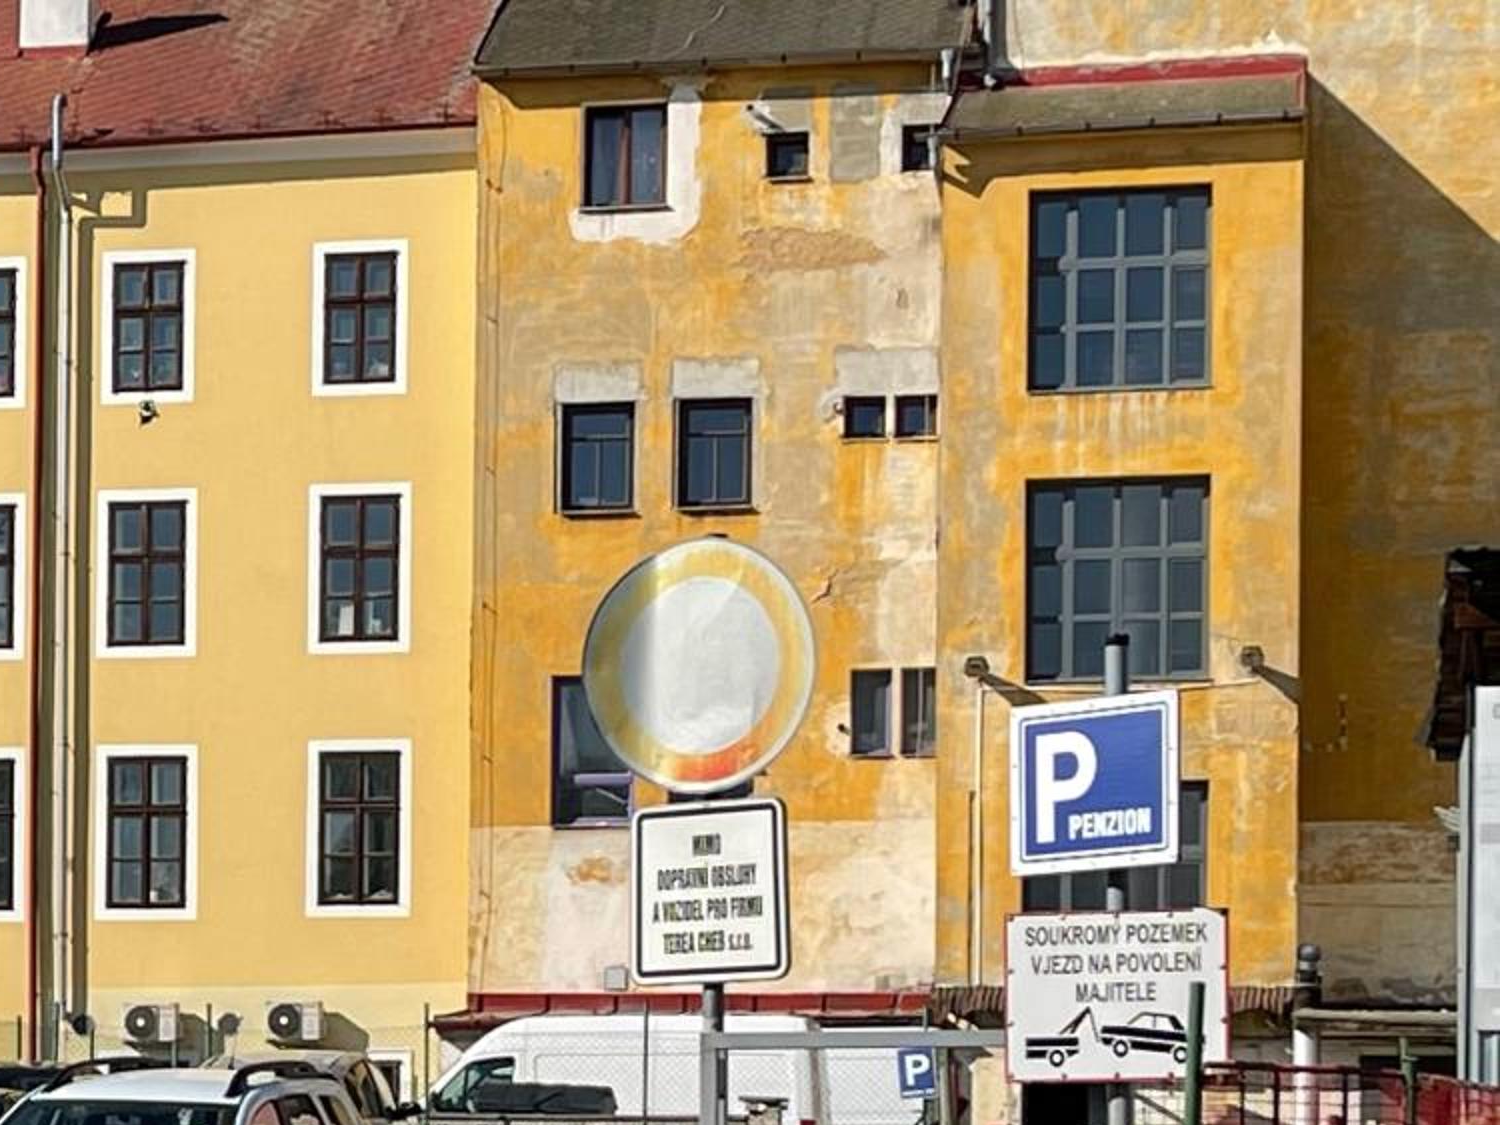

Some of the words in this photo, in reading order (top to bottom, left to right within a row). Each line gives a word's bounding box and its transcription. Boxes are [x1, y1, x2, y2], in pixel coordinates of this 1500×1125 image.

[1035, 730, 1097, 844] P
[1068, 807, 1152, 840] PENZION
[652, 901, 660, 925] A
[707, 897, 728, 920] PRO
[698, 929, 725, 952] CHEB
[1126, 923, 1208, 944] POZEMEK
[1031, 955, 1084, 975] VJEZD
[1088, 953, 1111, 975] NA
[1116, 948, 1203, 974] POVOLENÍ
[1075, 981, 1157, 1002] MAJITELE
[904, 1053, 931, 1087] P
